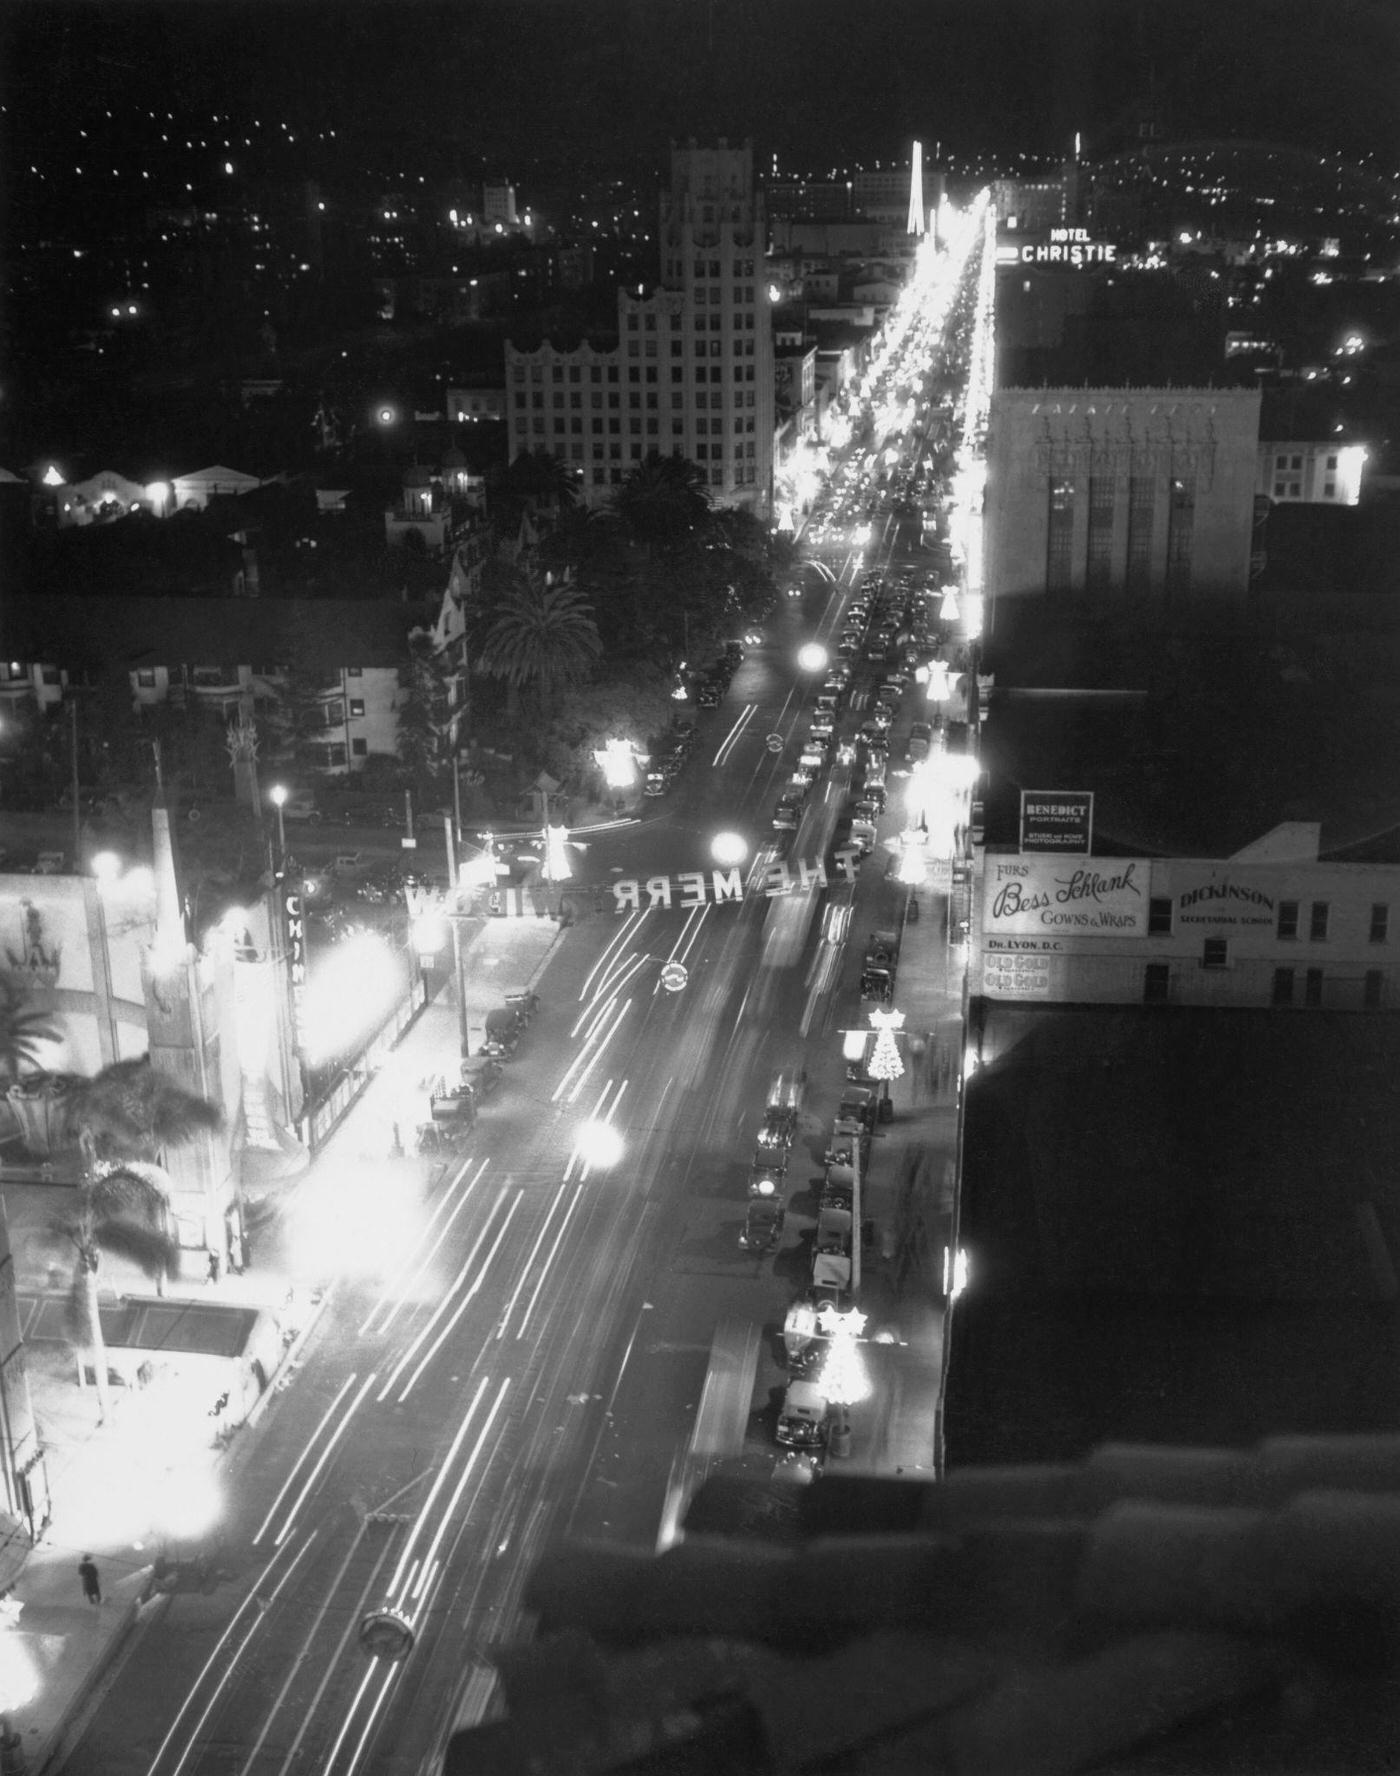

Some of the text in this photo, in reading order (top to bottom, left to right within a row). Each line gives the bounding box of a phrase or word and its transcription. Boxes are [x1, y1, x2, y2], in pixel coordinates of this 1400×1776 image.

[1050, 228, 1091, 242] HOTEL
[1021, 245, 1117, 263] CHRISTIE
[1026, 804, 1087, 816] BENEDICT
[996, 864, 1030, 881] FURS
[992, 863, 1141, 919] Bess Schlank
[1180, 884, 1274, 911] DICKINSON
[1041, 911, 1089, 926] GOWNS
[1099, 912, 1137, 928] WRAPS
[985, 955, 1049, 970] OLD GOLD
[985, 973, 1048, 988] OLD GOLD
